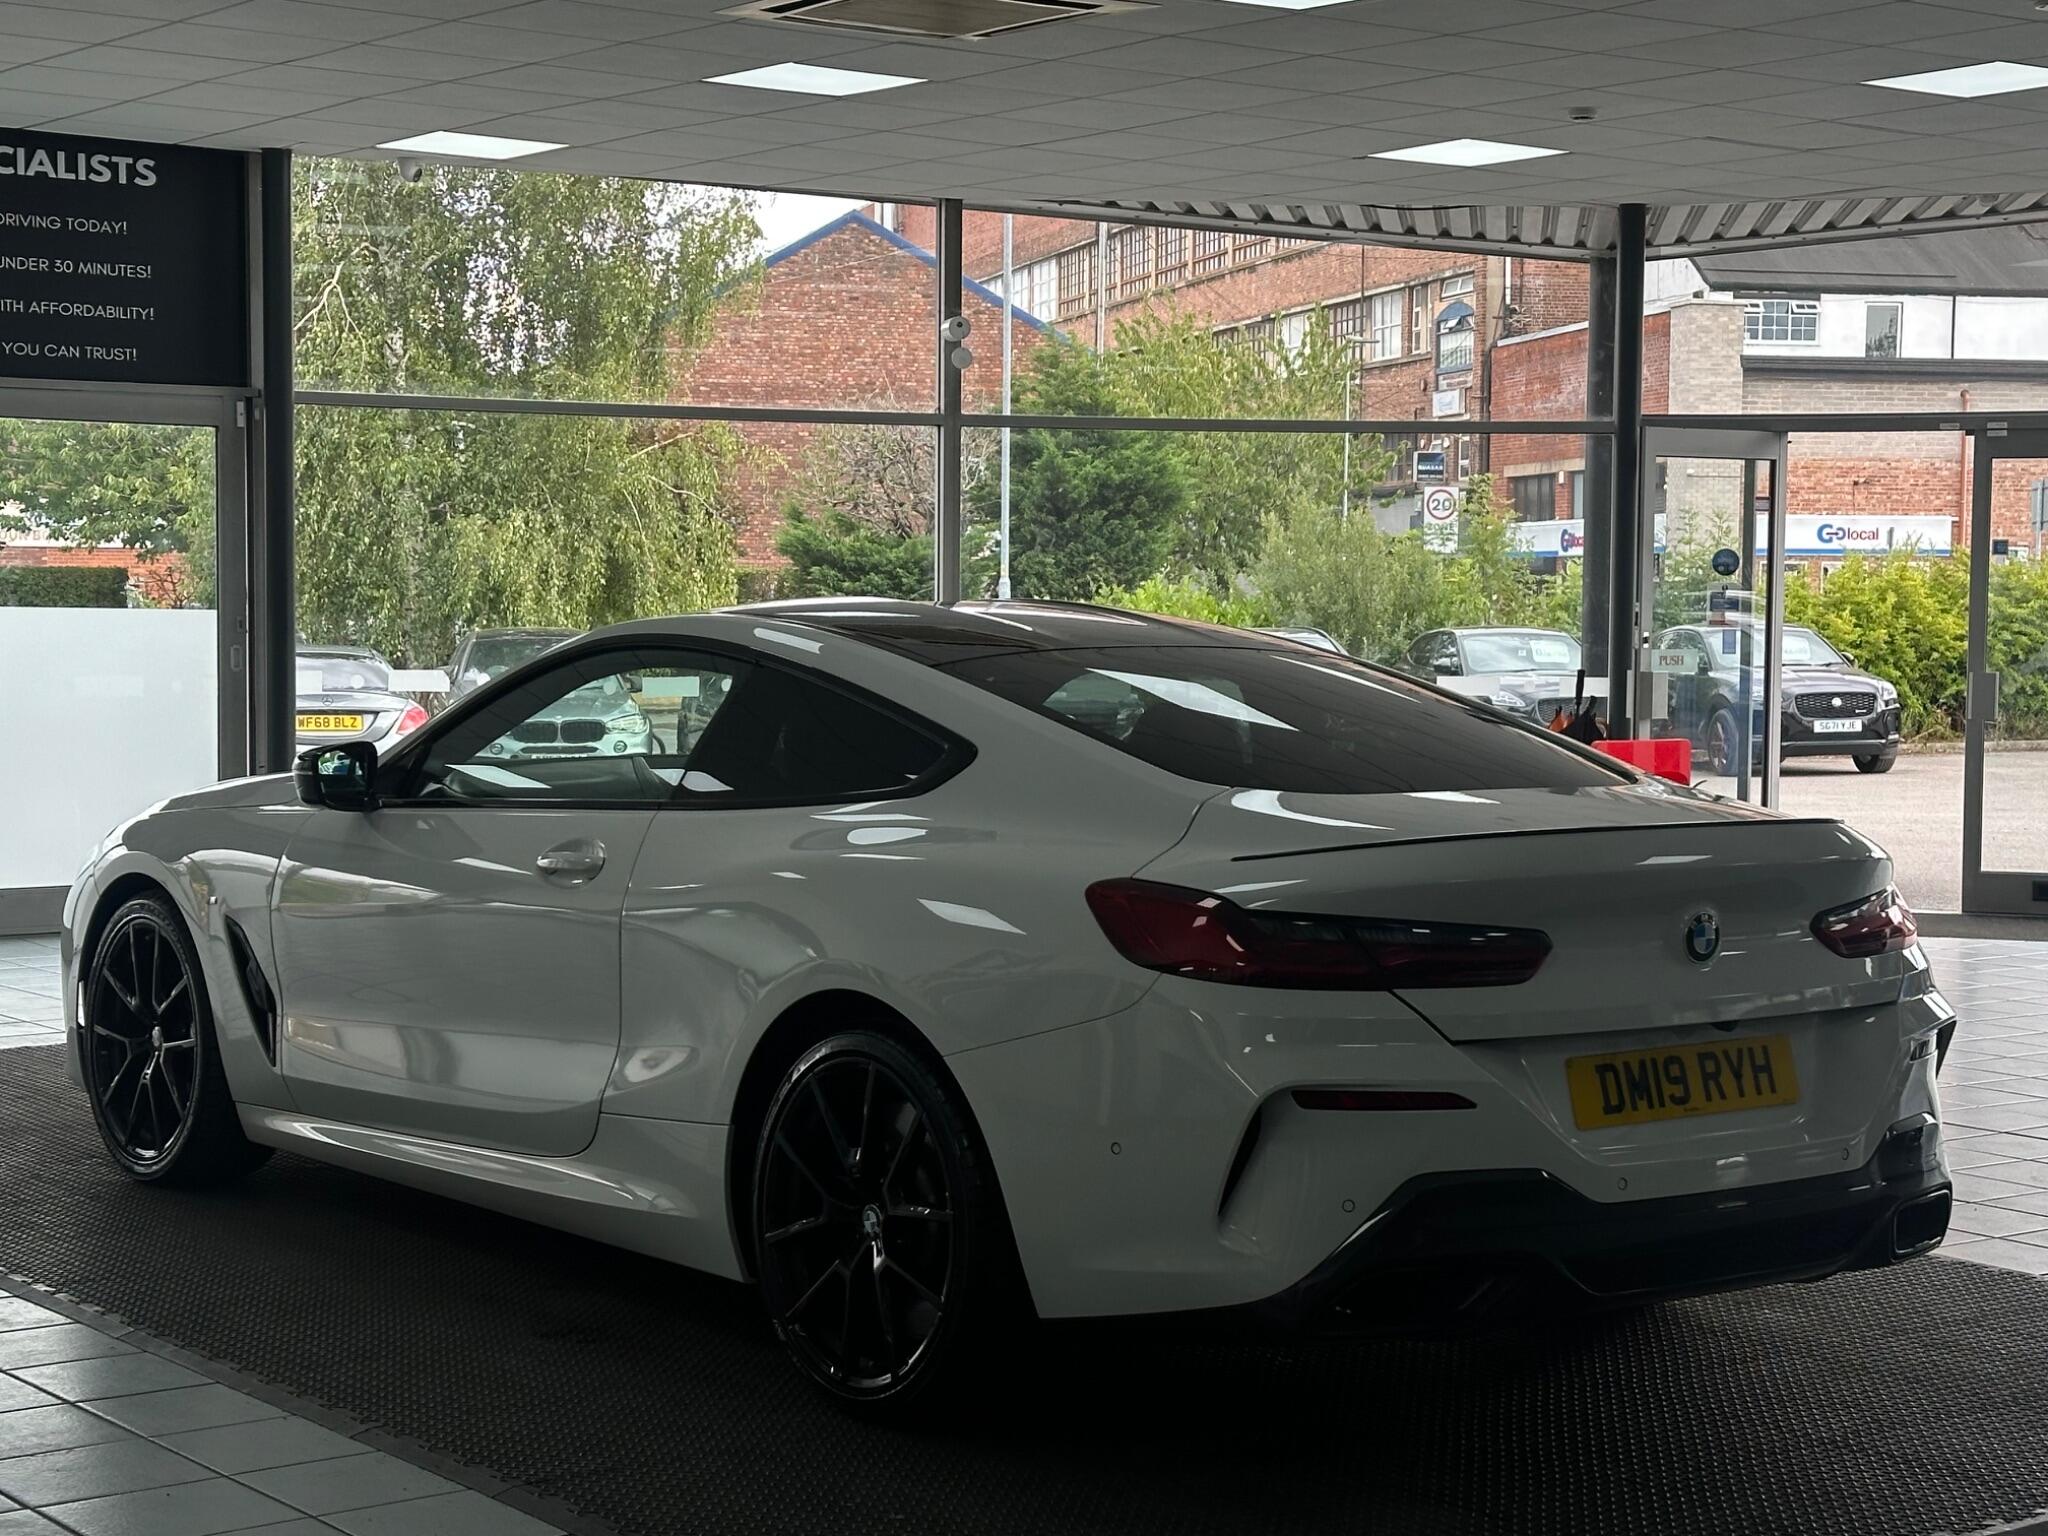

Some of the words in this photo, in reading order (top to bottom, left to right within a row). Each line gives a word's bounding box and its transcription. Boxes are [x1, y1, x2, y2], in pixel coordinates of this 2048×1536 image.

[0, 146, 157, 187] CIALISTS
[66, 218, 128, 235] TODAY!
[54, 259, 73, 274] 30
[78, 262, 152, 279] MINUTES!
[28, 301, 155, 321] AFFORDABILITY!
[2, 342, 40, 356] YOU
[44, 344, 80, 358] CAN
[84, 346, 137, 361] TRUST!
[1431, 498, 1452, 511] 20
[1659, 655, 1684, 666] PUSH
[298, 717, 330, 728] WF68
[334, 717, 357, 728] BLZ
[1594, 1055, 1691, 1115] DM19
[1697, 1045, 1777, 1102] RYH
